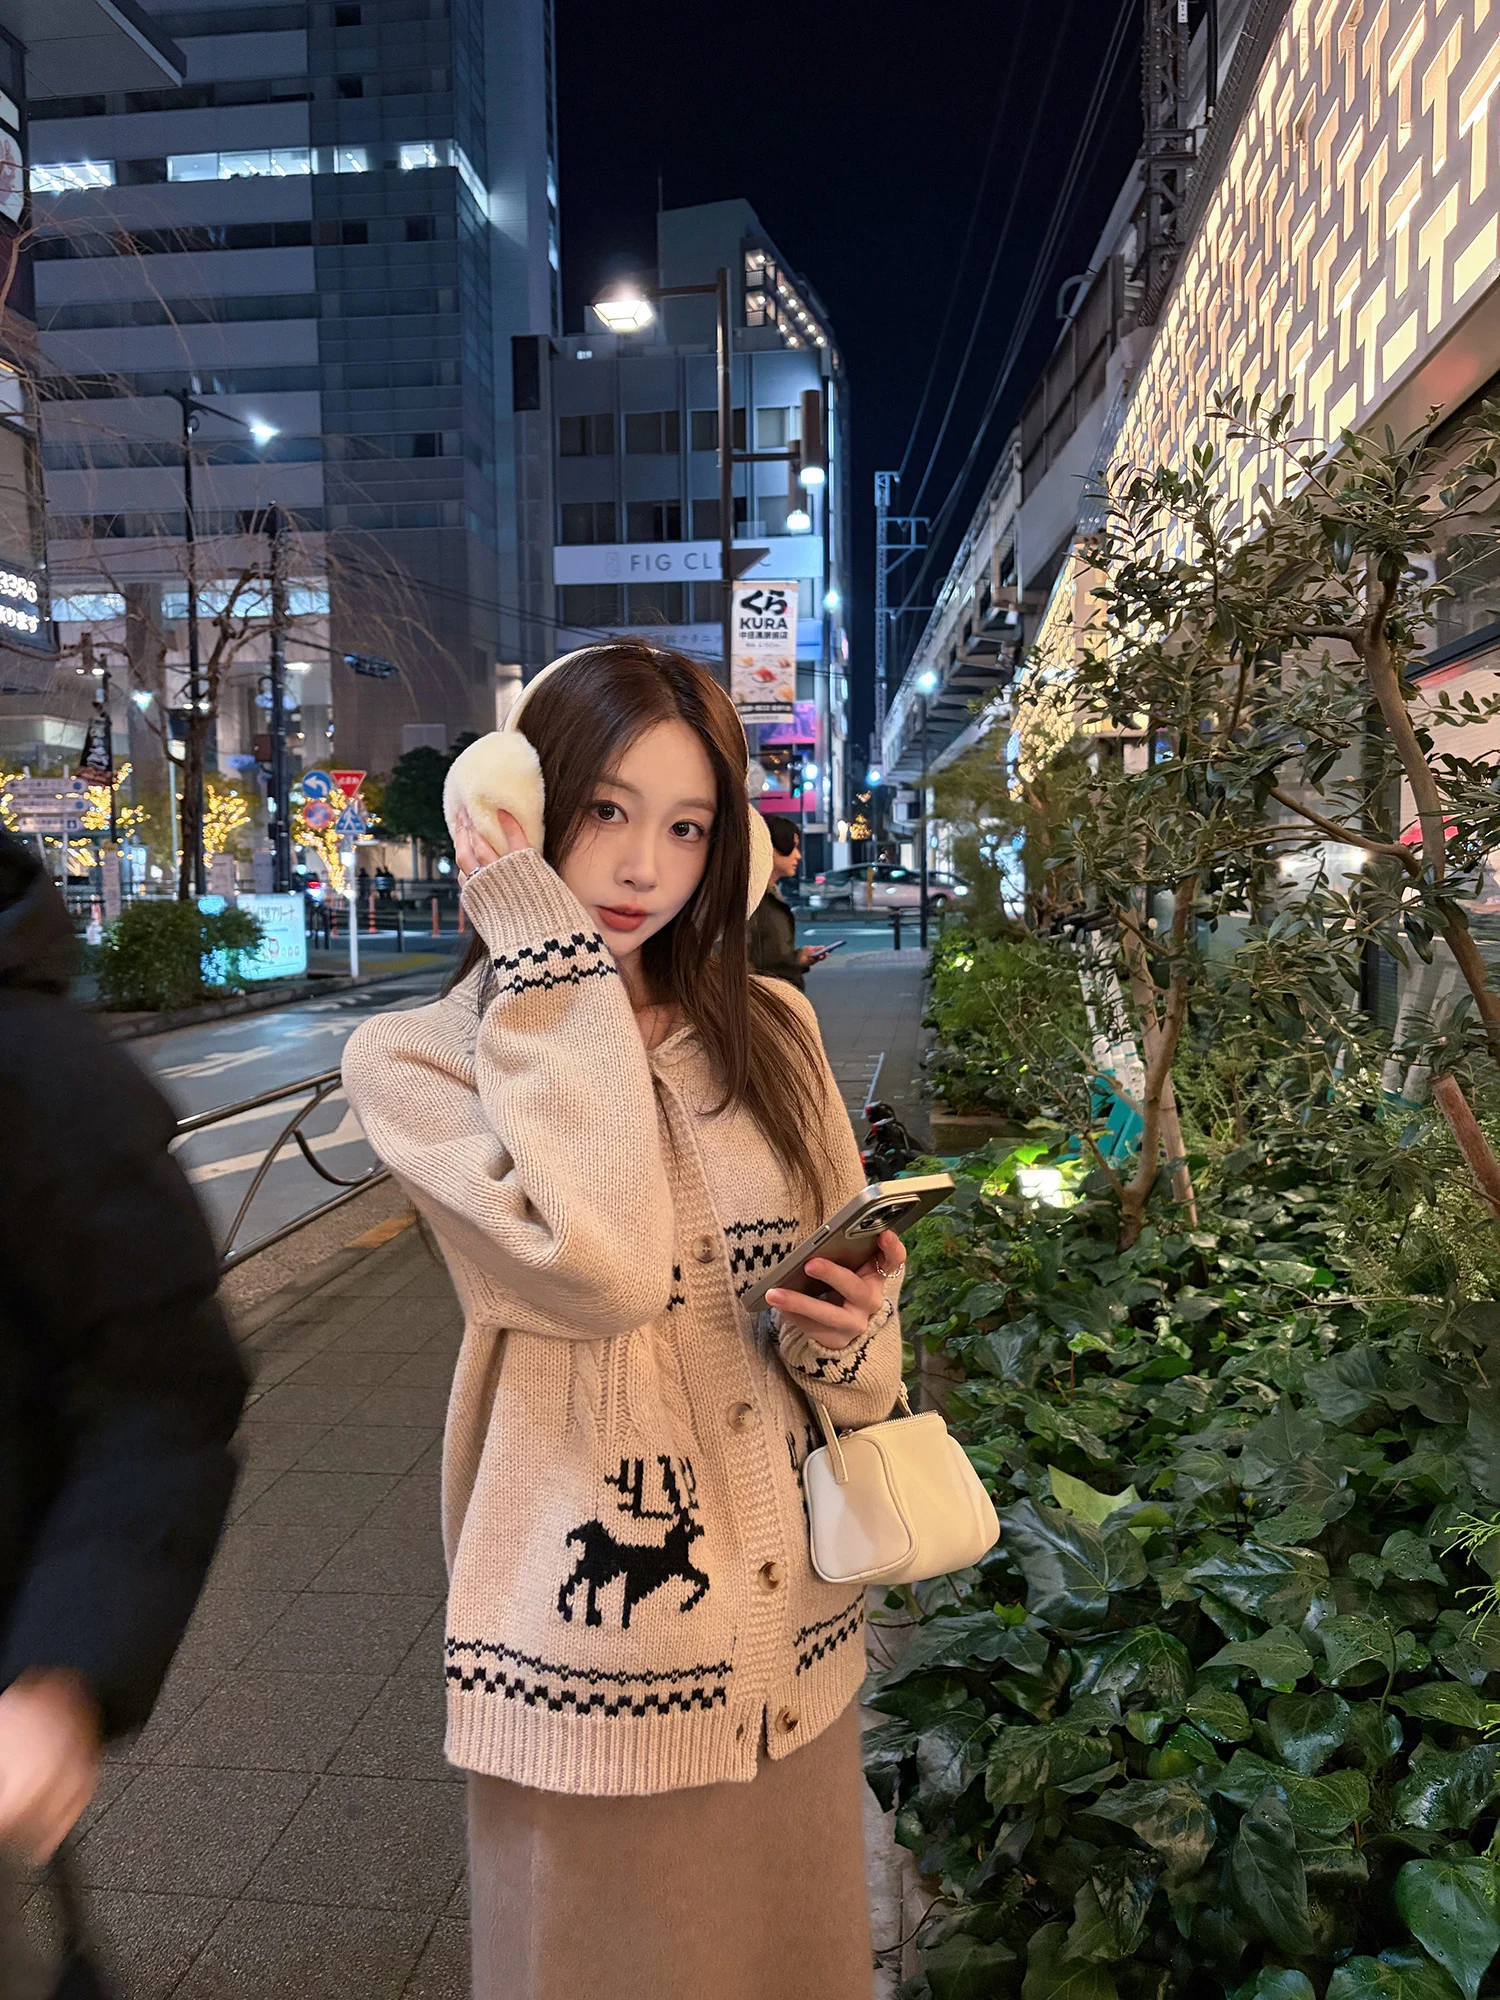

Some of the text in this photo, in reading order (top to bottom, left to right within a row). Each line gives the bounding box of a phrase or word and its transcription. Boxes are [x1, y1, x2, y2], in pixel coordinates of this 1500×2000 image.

[630, 554, 672, 572] FIG
[741, 589, 787, 615] くら
[740, 617, 788, 630] KURA
